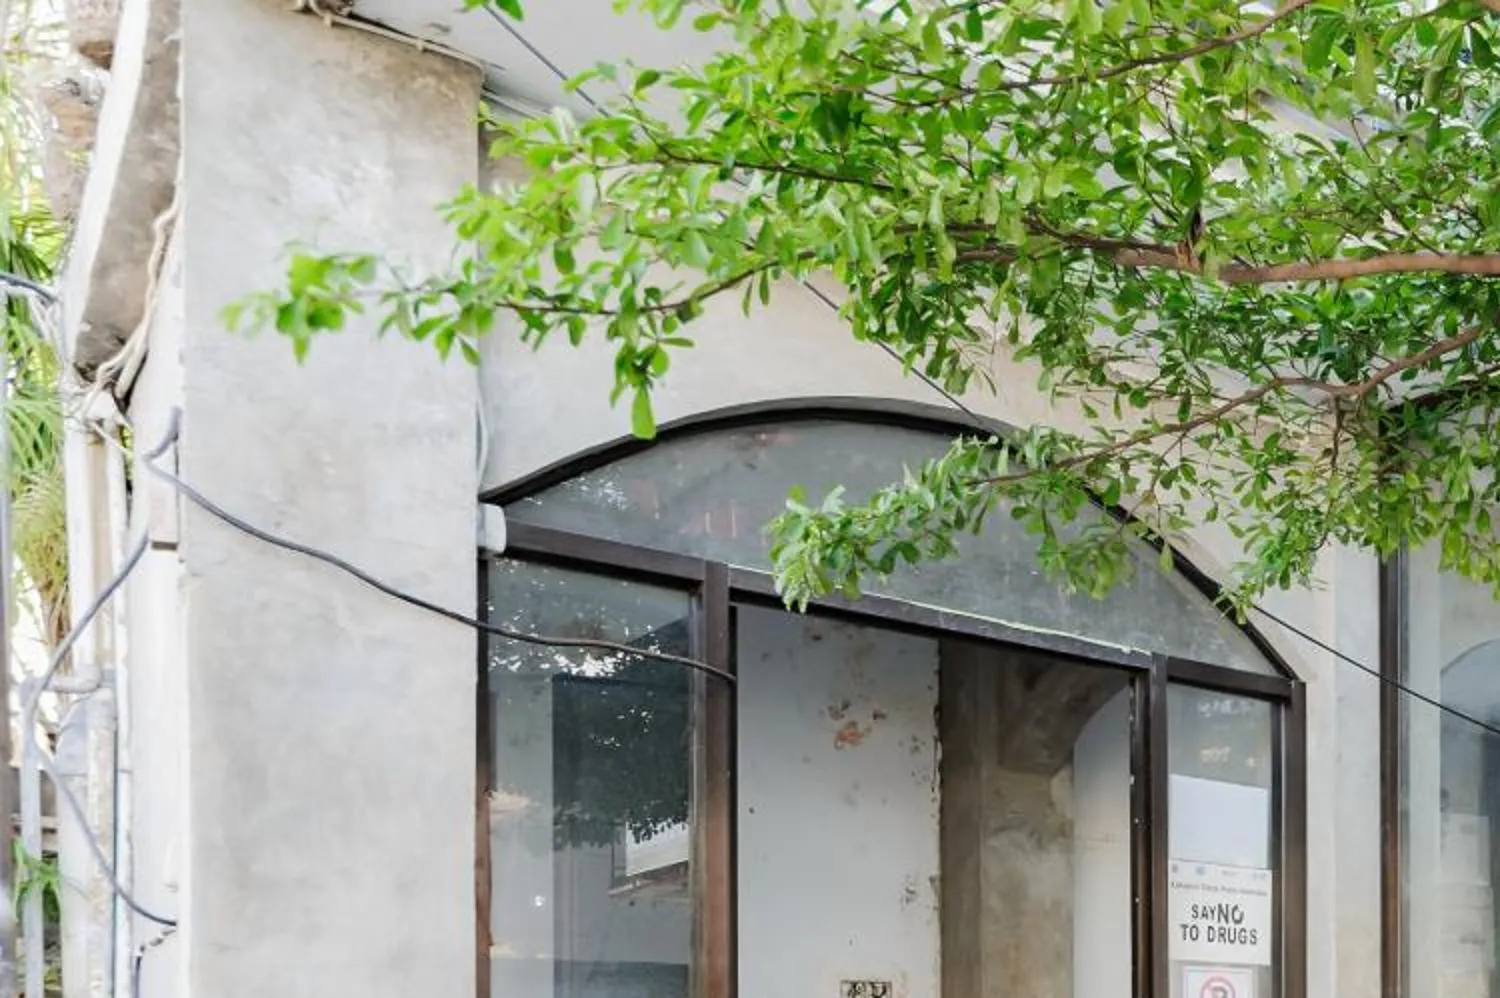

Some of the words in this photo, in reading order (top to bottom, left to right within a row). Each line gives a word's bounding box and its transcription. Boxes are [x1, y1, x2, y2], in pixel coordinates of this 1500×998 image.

[1191, 903, 1217, 920] SAY
[1217, 903, 1244, 925] NO
[1179, 923, 1200, 942] TO
[1206, 925, 1258, 945] DRUGS
